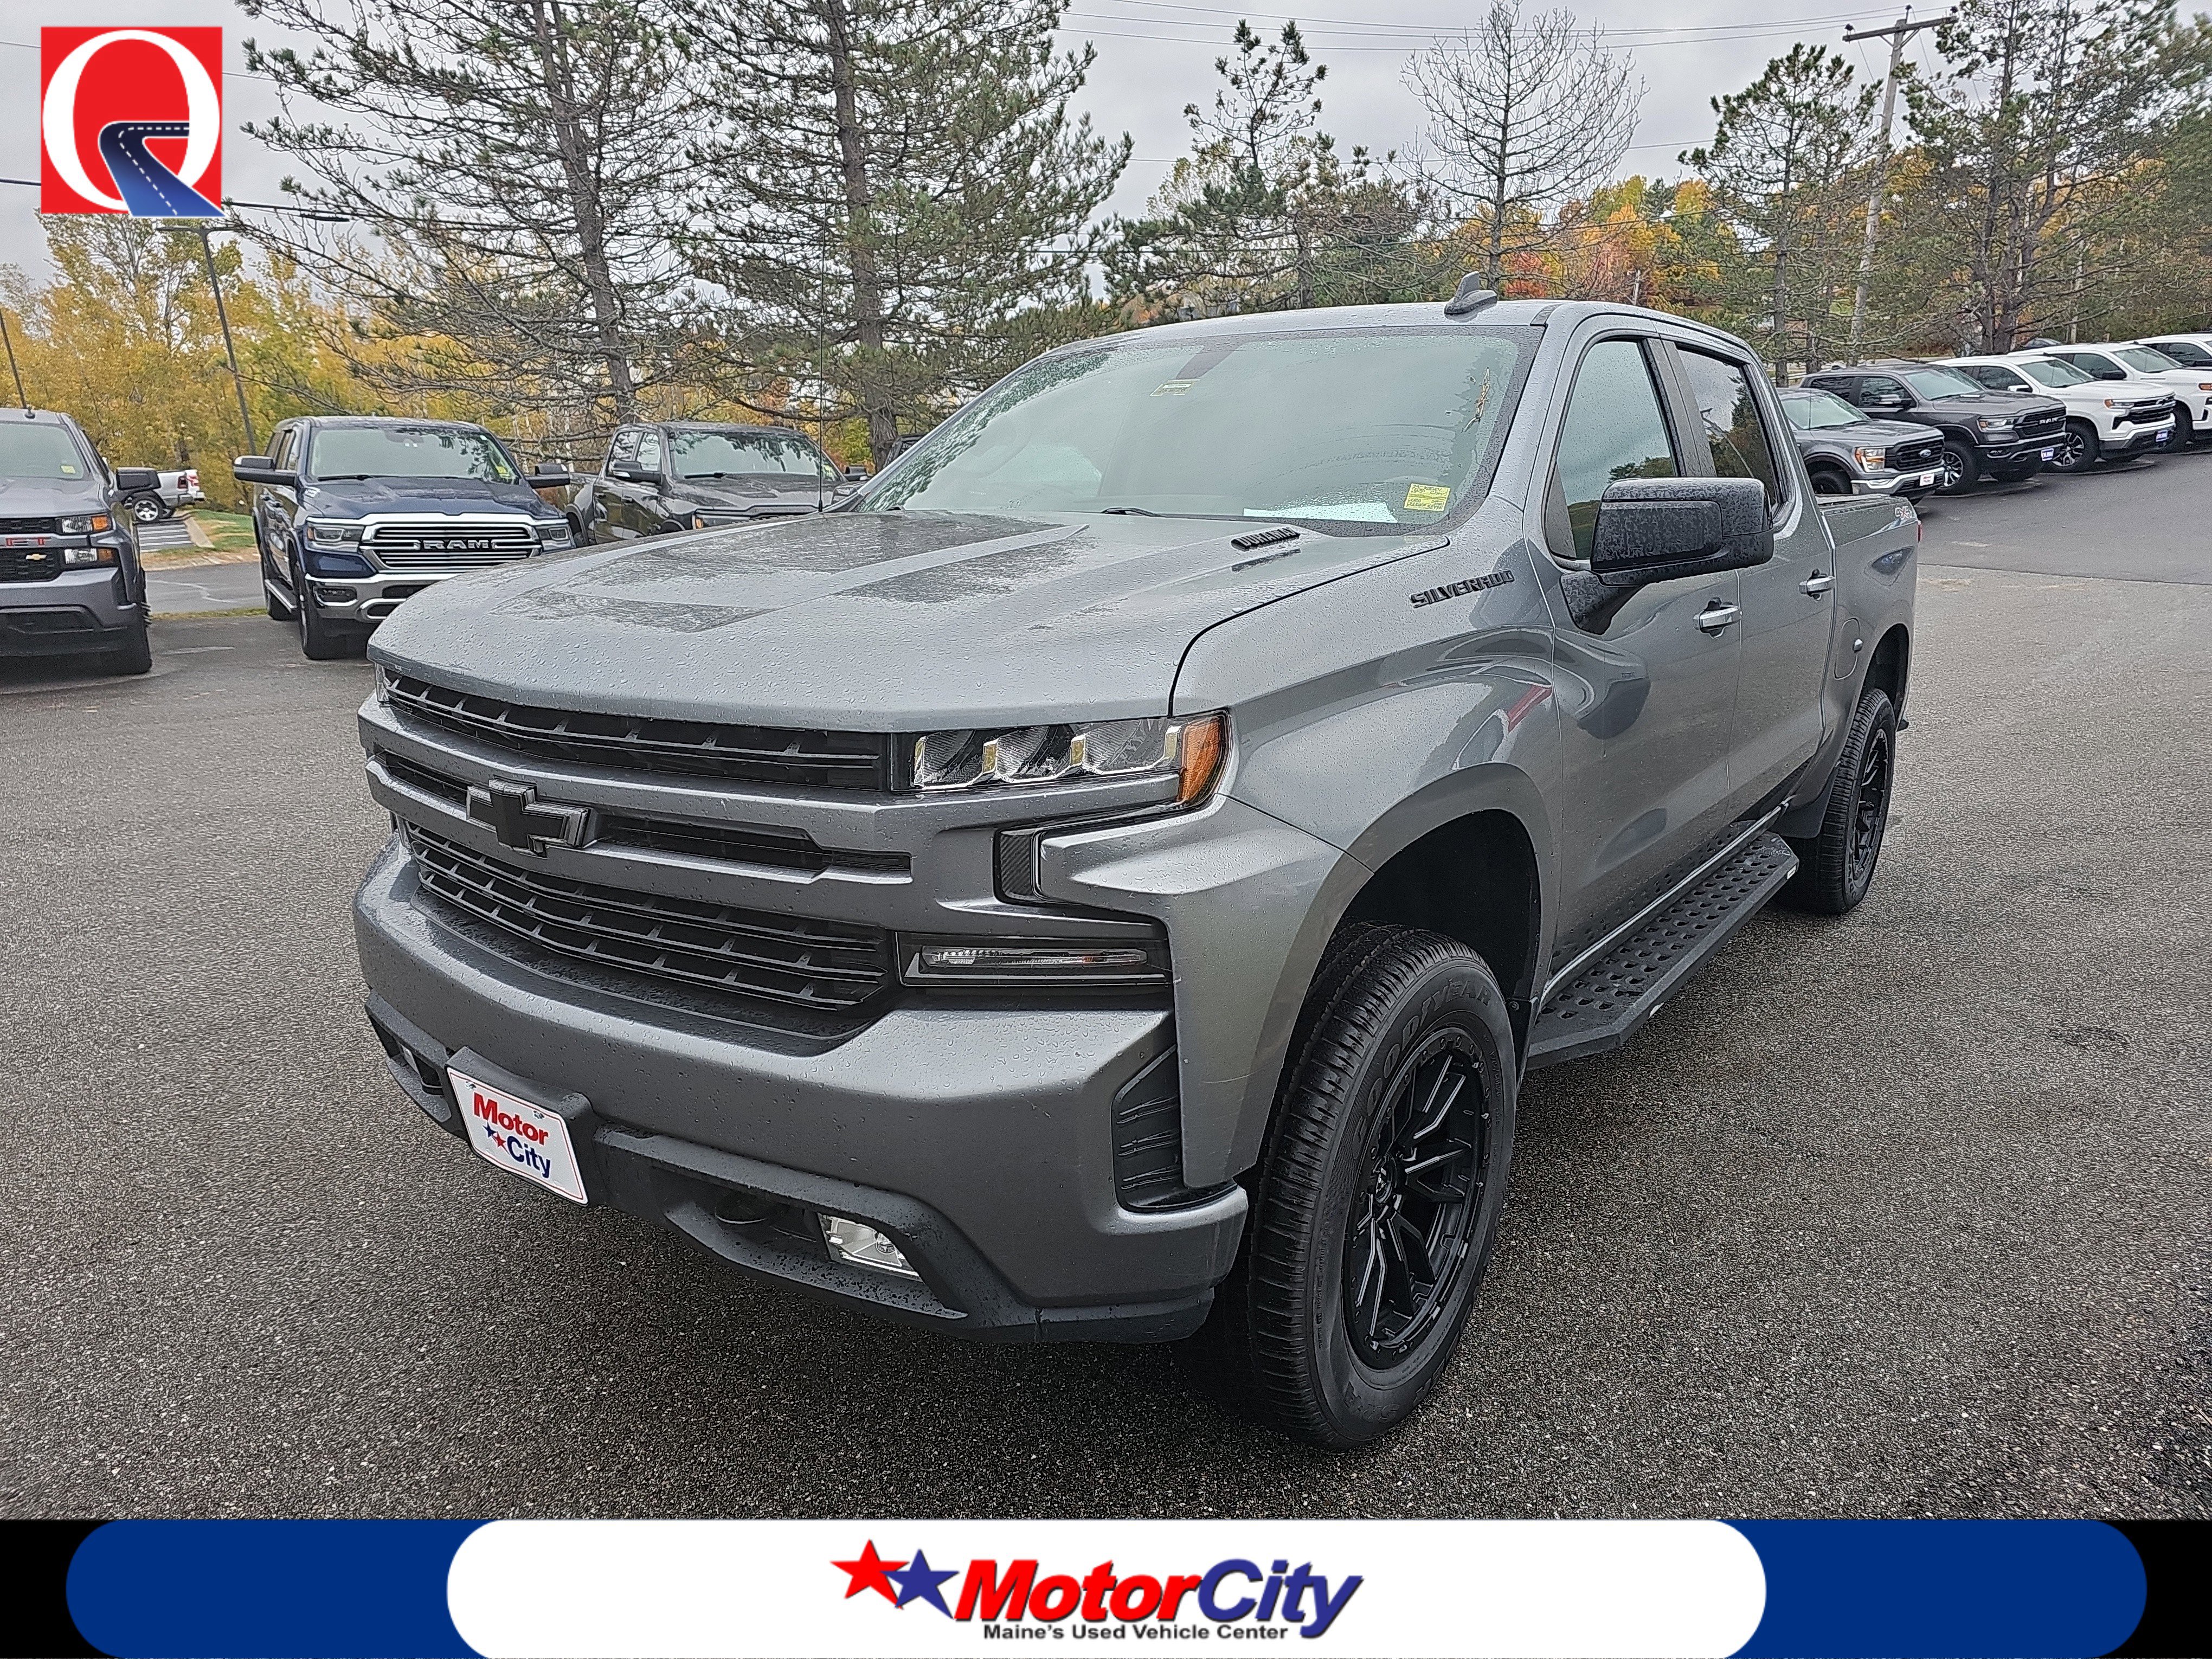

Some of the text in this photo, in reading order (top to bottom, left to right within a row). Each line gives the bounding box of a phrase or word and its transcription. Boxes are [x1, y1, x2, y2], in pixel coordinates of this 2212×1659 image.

[423, 539, 490, 549] RAM
[1411, 570, 1515, 609] SILVERADO
[473, 1092, 549, 1146] Motor
[507, 1135, 551, 1179] City
